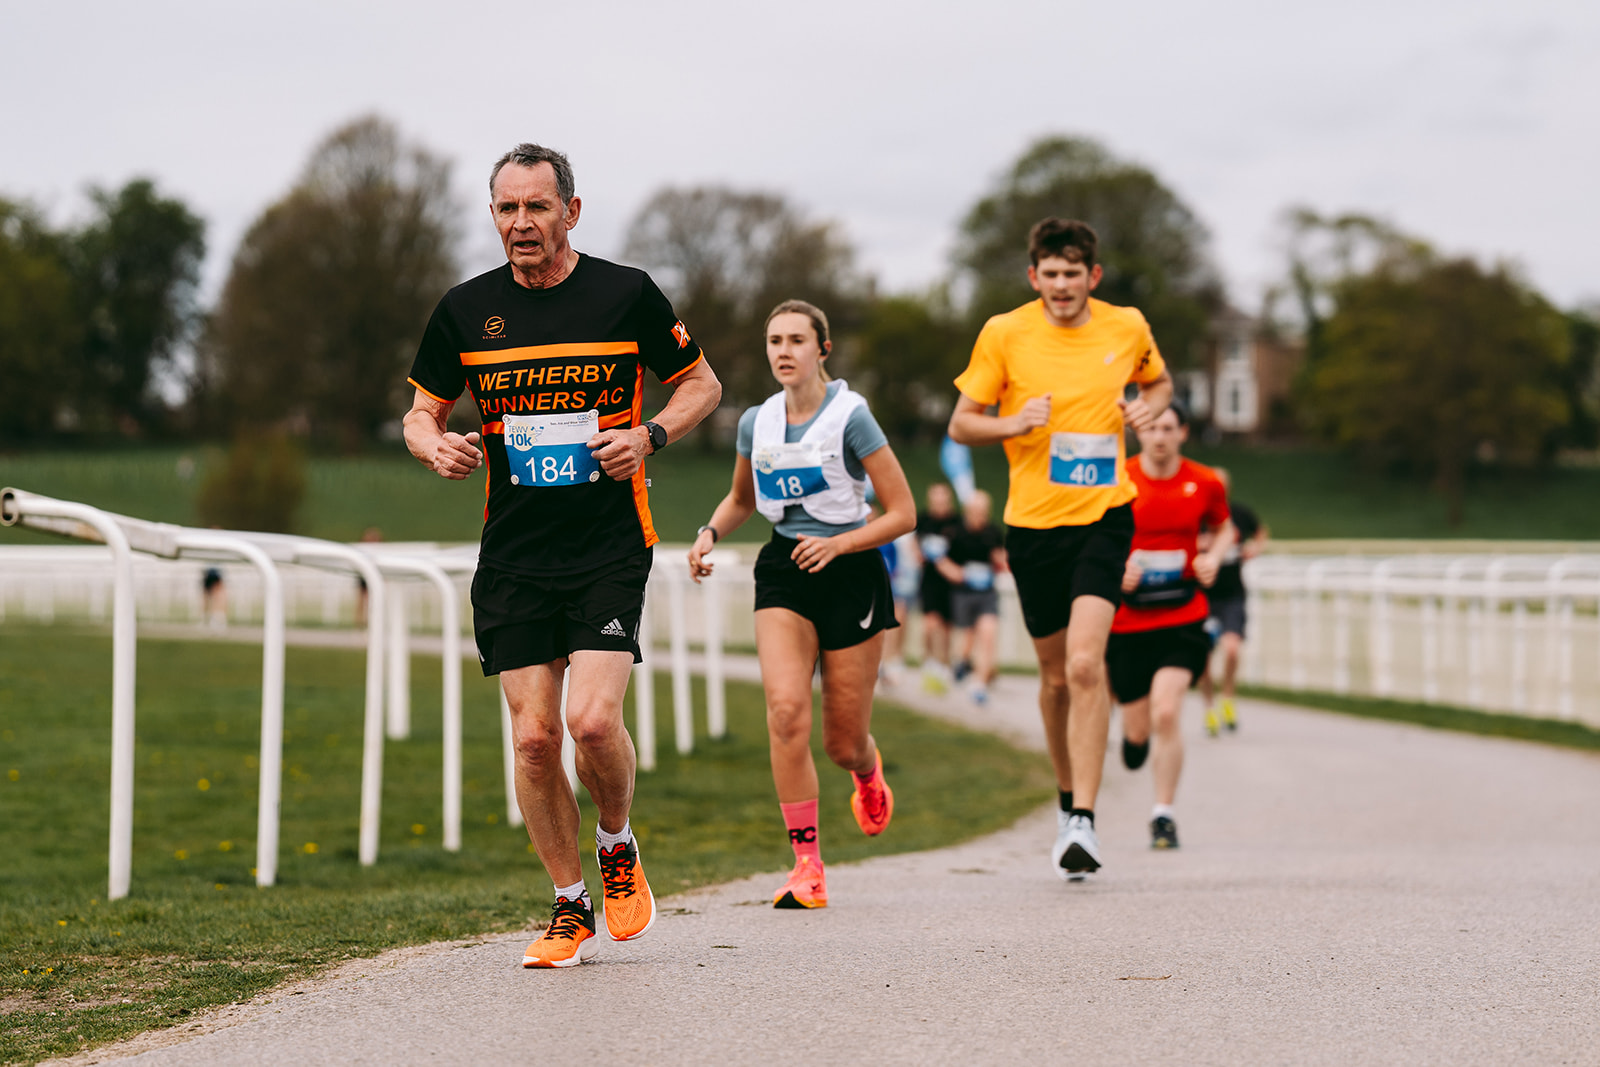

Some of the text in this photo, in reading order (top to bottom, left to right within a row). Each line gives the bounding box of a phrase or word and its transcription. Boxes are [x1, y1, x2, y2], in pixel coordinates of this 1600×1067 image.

[479, 363, 617, 392] WETHERBY
[480, 387, 625, 416] RUNNERS AC
[508, 425, 529, 433] TEWV
[508, 433, 533, 447] 10k
[525, 455, 578, 483] 184
[1069, 463, 1099, 486] 40
[775, 475, 804, 498] 18
[600, 628, 627, 638] adidas
